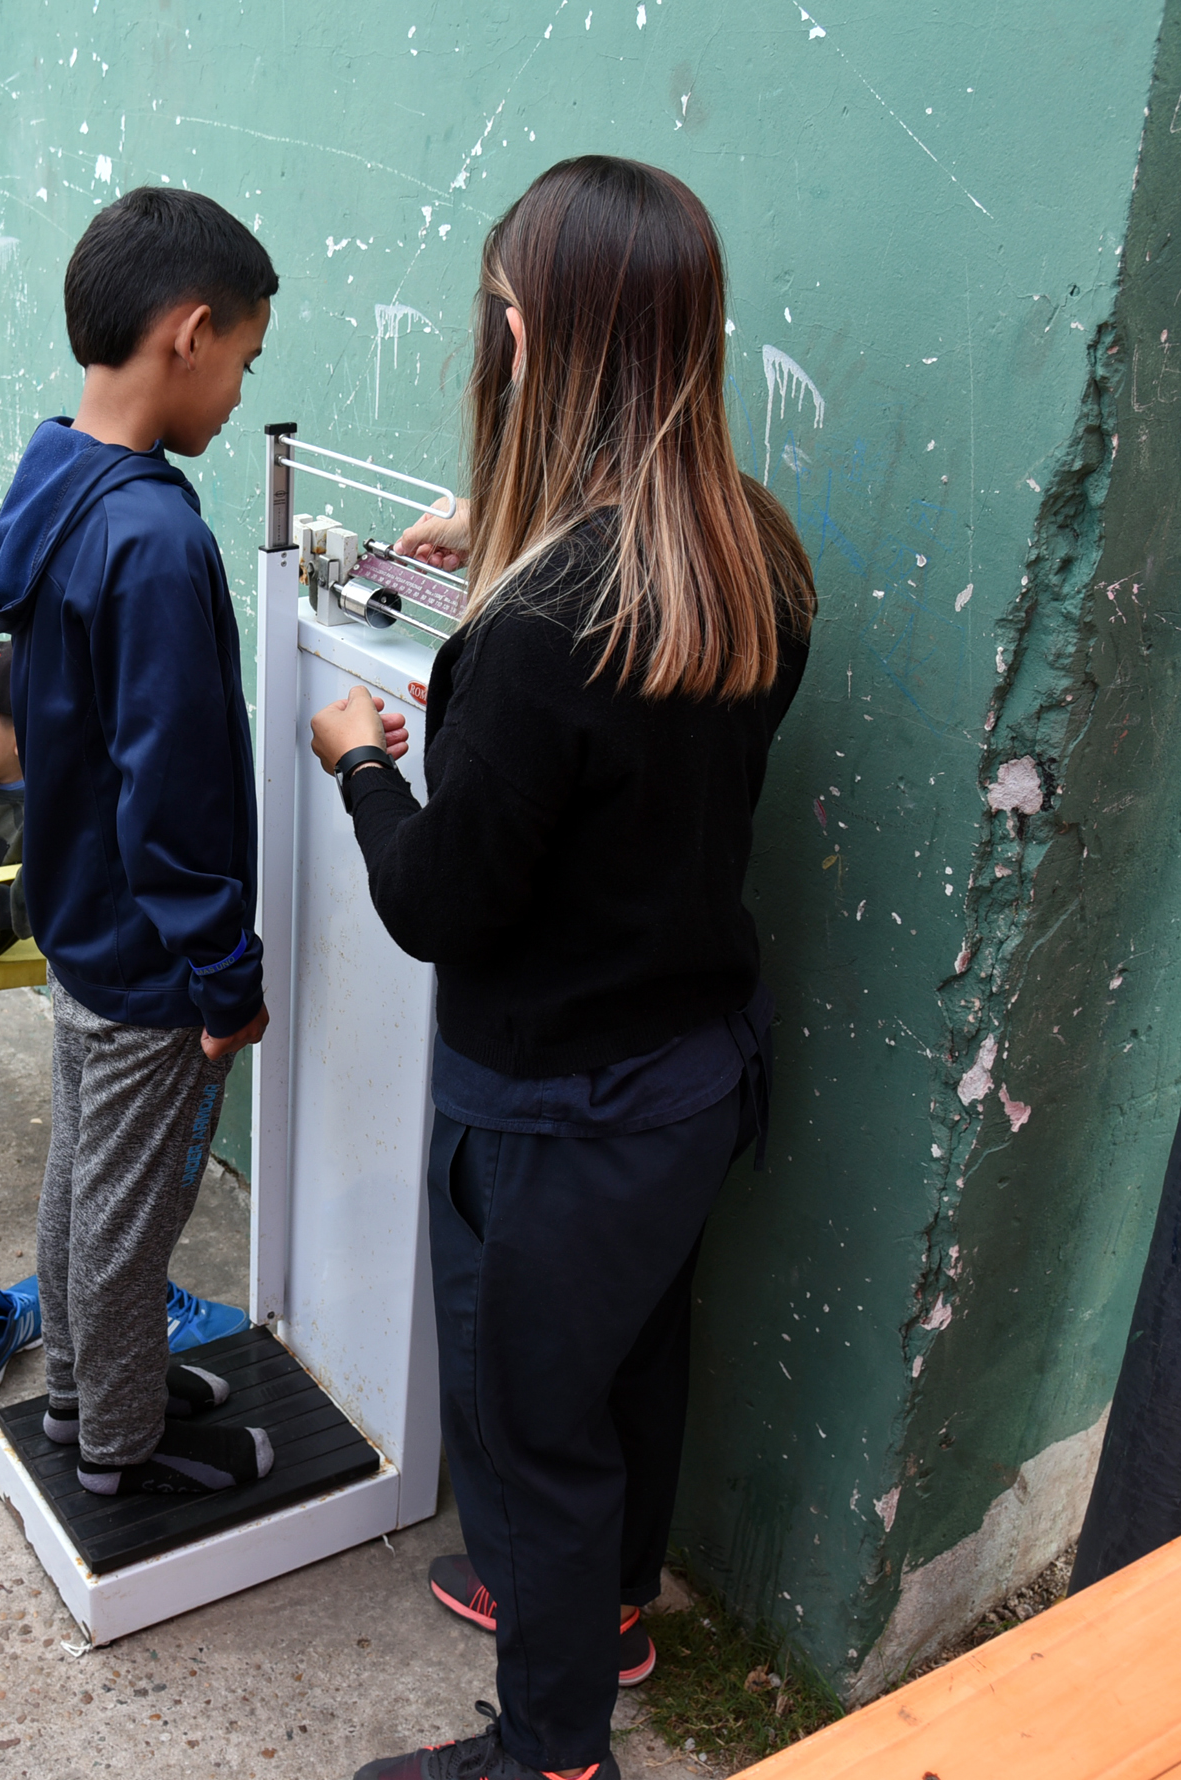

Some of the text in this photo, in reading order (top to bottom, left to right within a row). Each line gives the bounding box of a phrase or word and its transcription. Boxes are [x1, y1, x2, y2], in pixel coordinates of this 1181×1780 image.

[216, 956, 235, 971] UNO
[181, 1084, 221, 1188] UNDER ARMOUR
